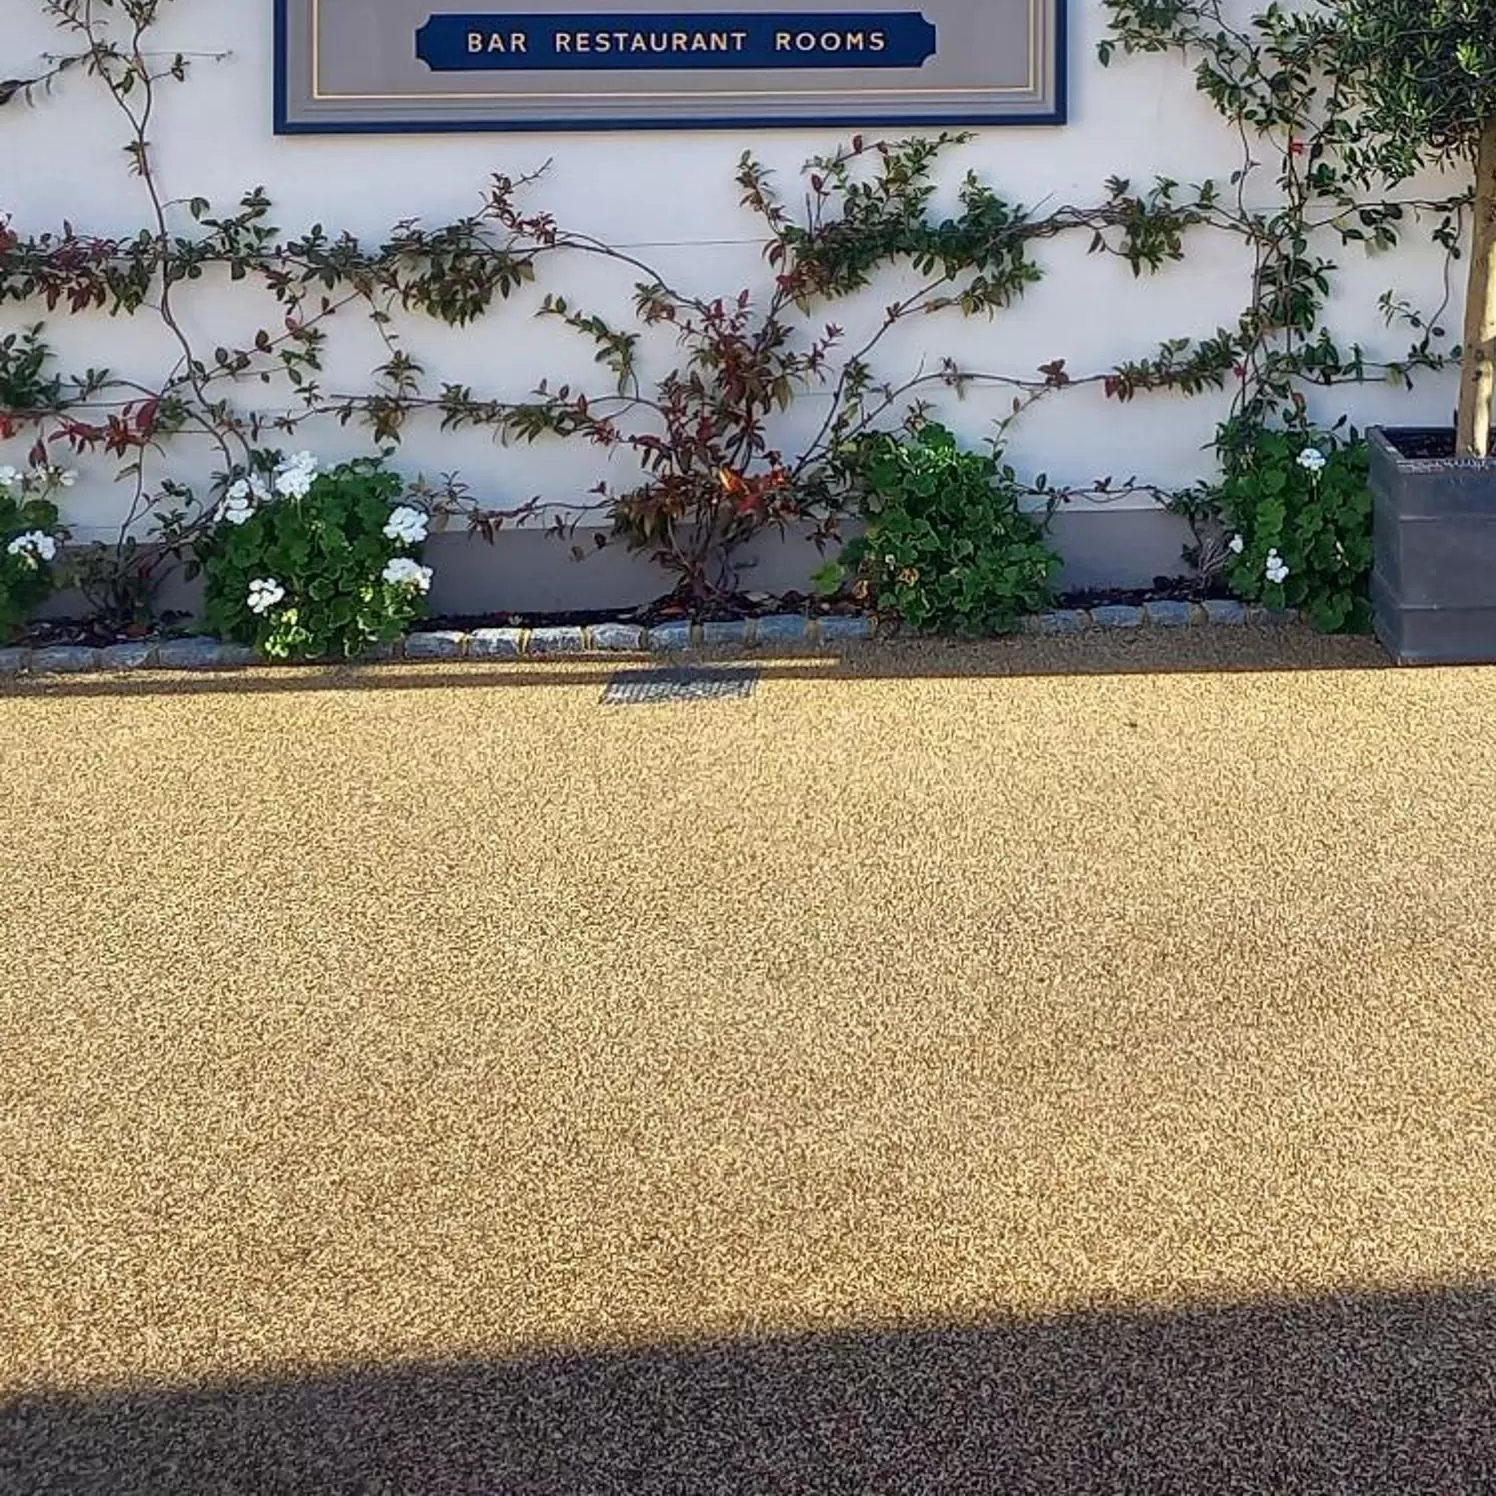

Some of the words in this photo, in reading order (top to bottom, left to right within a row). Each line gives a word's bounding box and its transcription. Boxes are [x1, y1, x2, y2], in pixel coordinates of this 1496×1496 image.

[467, 32, 527, 53] BAR
[555, 32, 747, 52] RESTAURANT
[775, 32, 885, 51] ROOMS
